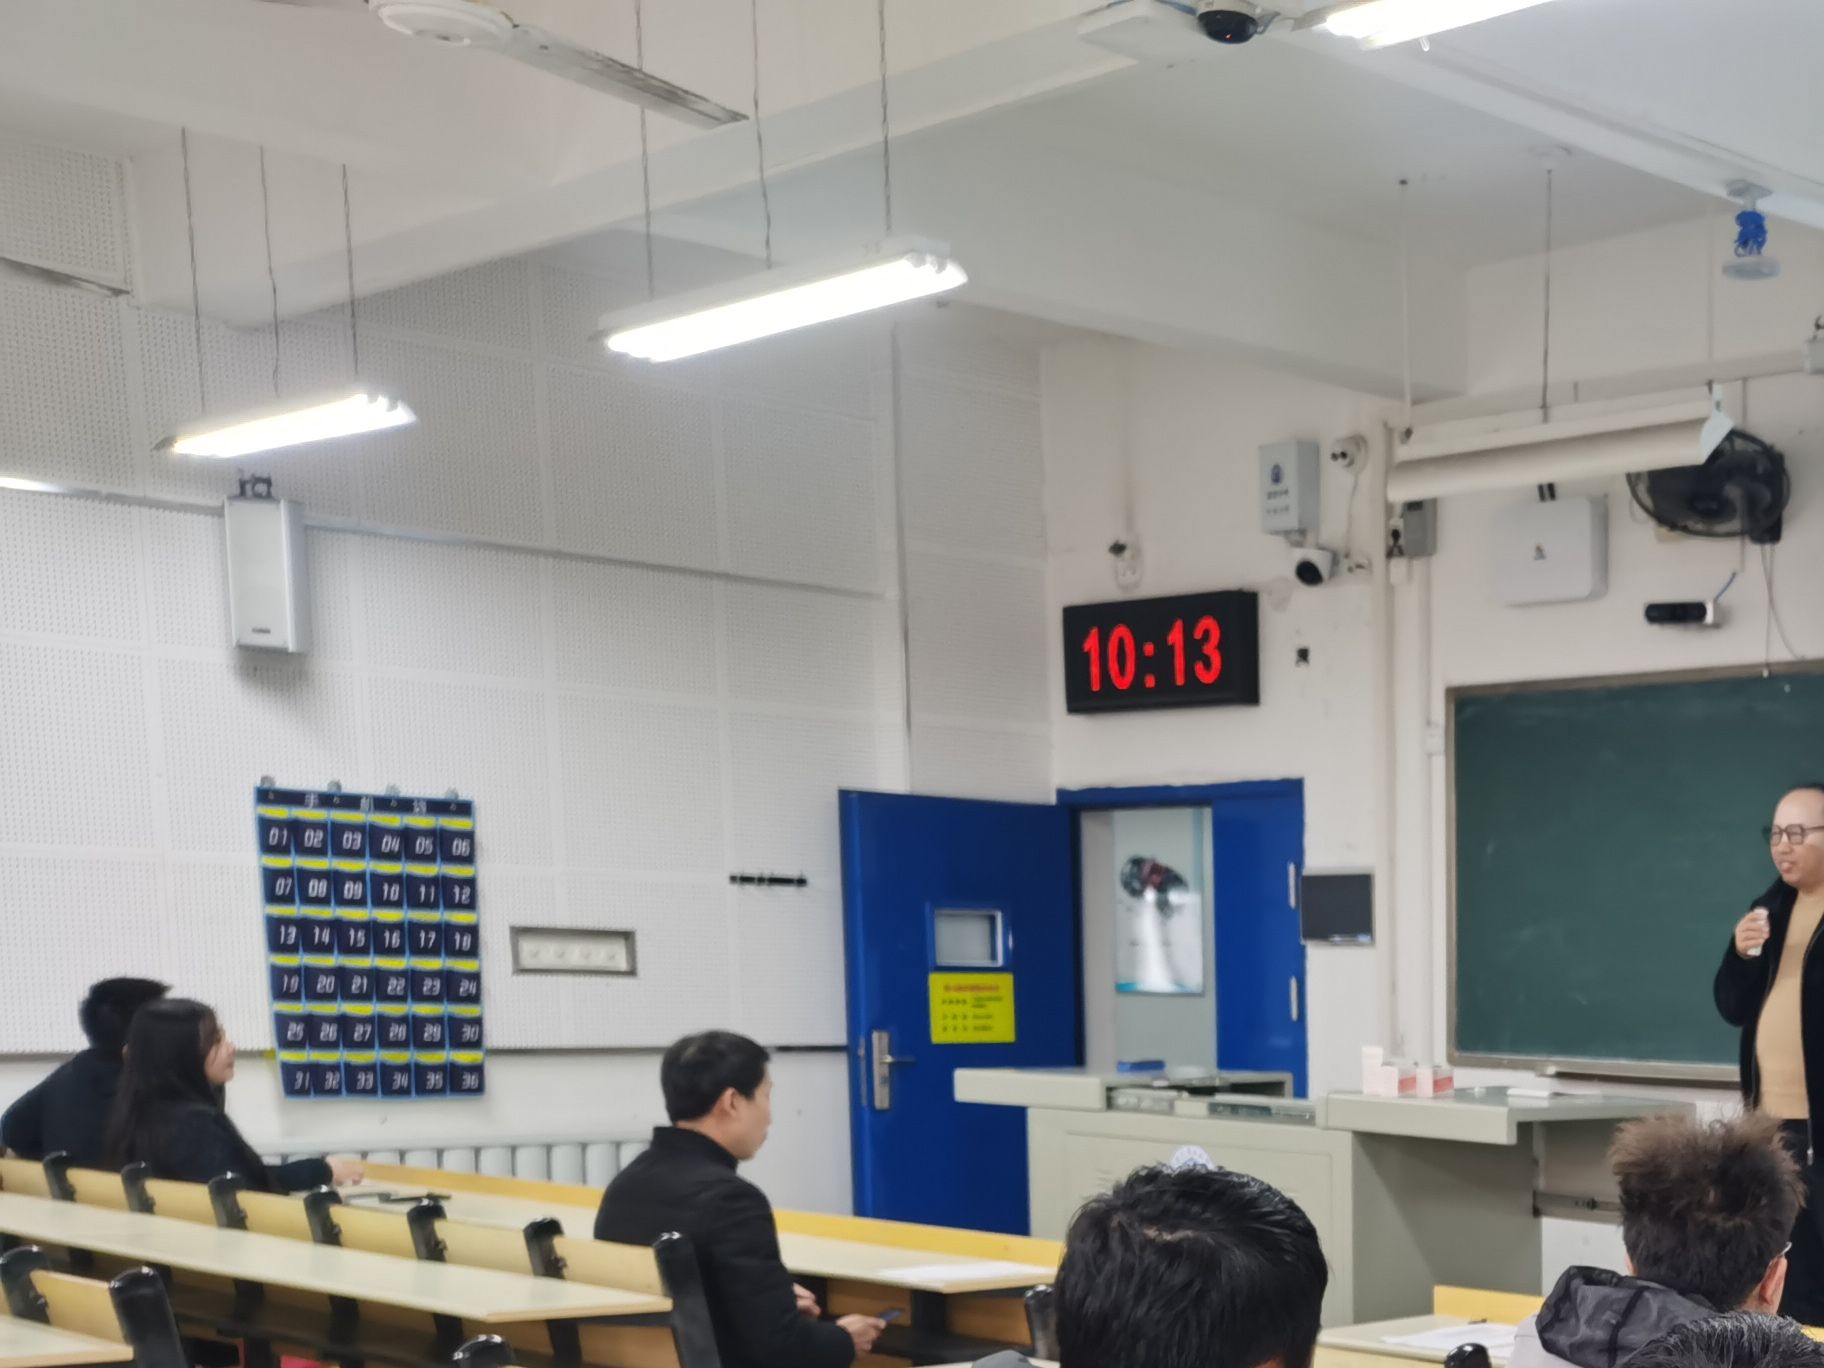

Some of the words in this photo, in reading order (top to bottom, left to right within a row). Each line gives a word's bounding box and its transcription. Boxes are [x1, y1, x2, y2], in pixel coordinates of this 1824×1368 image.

[1082, 615, 1223, 692] 10:13
[269, 827, 287, 846] 01
[304, 829, 323, 848] 02
[343, 831, 361, 849] 03
[382, 835, 400, 853] 04
[416, 836, 433, 855] 05
[452, 838, 470, 856] 06
[276, 877, 292, 895] 07
[309, 879, 327, 897] 08
[344, 881, 362, 899] 09
[383, 882, 399, 900] 10
[420, 884, 435, 902] 11
[280, 925, 296, 945] 13
[314, 926, 330, 945] 14
[350, 928, 365, 947] 15
[384, 930, 400, 948] 16
[420, 931, 435, 949] 17
[283, 975, 298, 993] 19
[317, 975, 334, 993] 20
[352, 975, 367, 993] 21
[387, 977, 405, 995] 22
[423, 977, 440, 995] 23
[459, 979, 476, 997] 24
[354, 1023, 371, 1042] 27
[424, 1023, 441, 1042] 29
